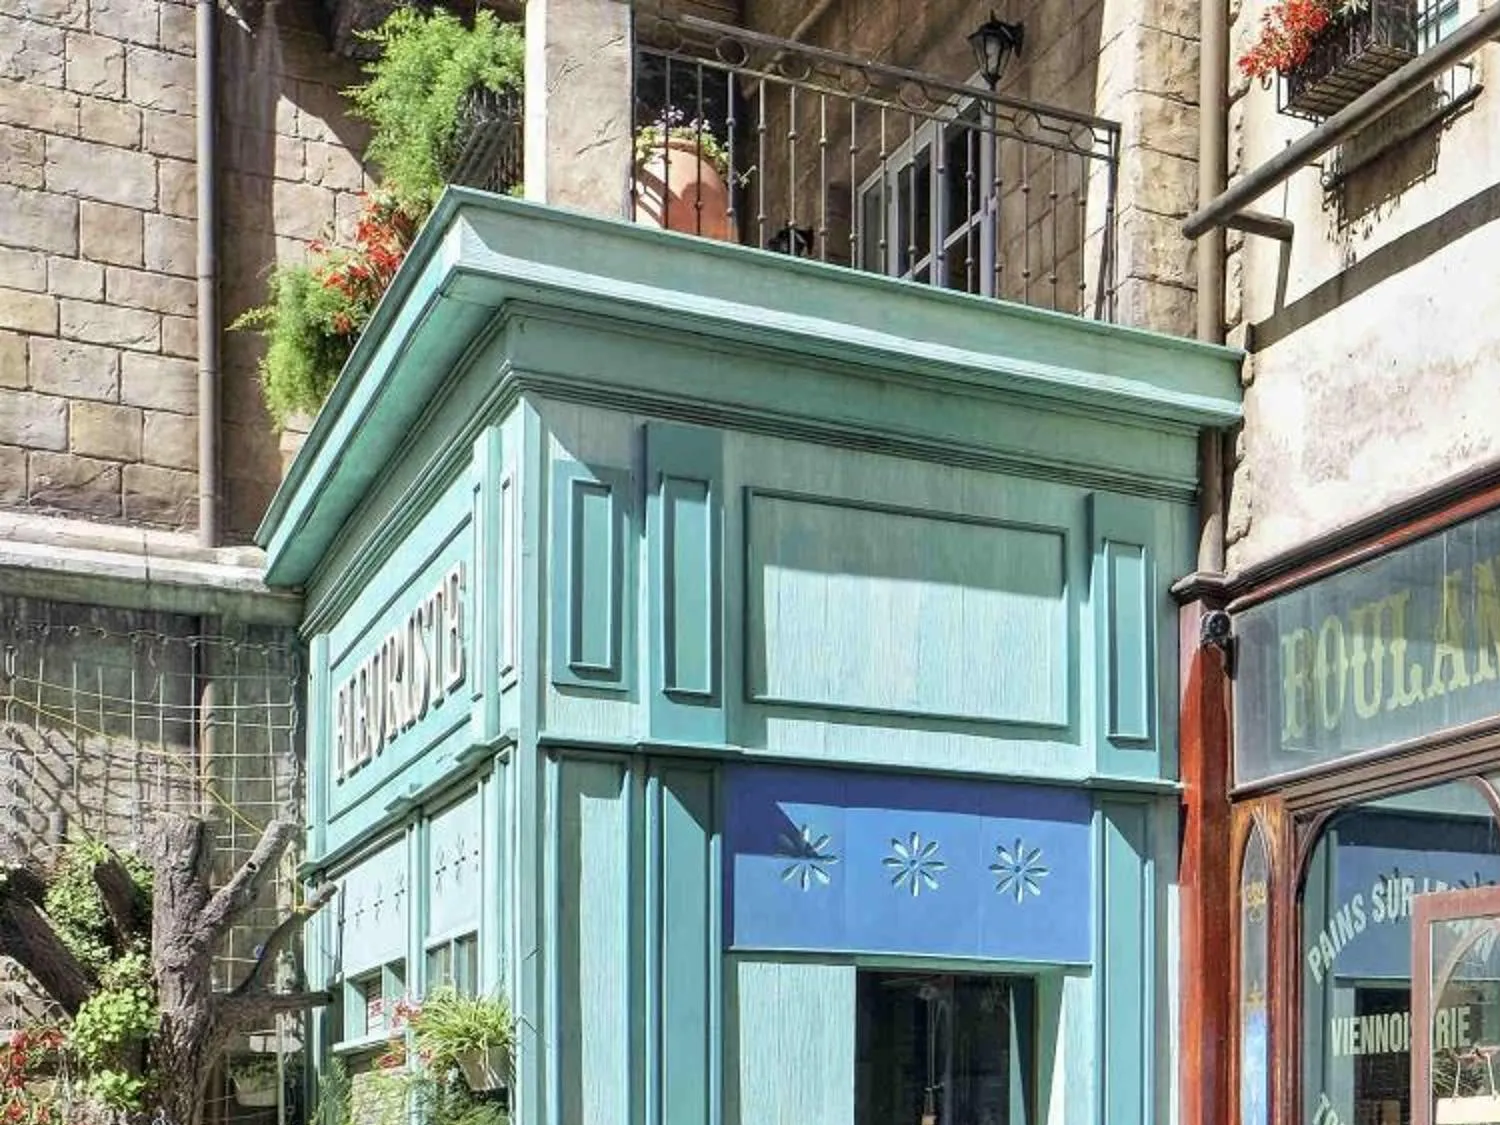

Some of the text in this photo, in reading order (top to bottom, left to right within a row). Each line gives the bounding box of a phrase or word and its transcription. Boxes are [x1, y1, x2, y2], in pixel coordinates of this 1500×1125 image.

[336, 560, 467, 785] FLEURISTE
[1308, 893, 1367, 984] PAINS
[1371, 876, 1415, 924] SUR
[1331, 1006, 1472, 1057] VIENNOIRIE
